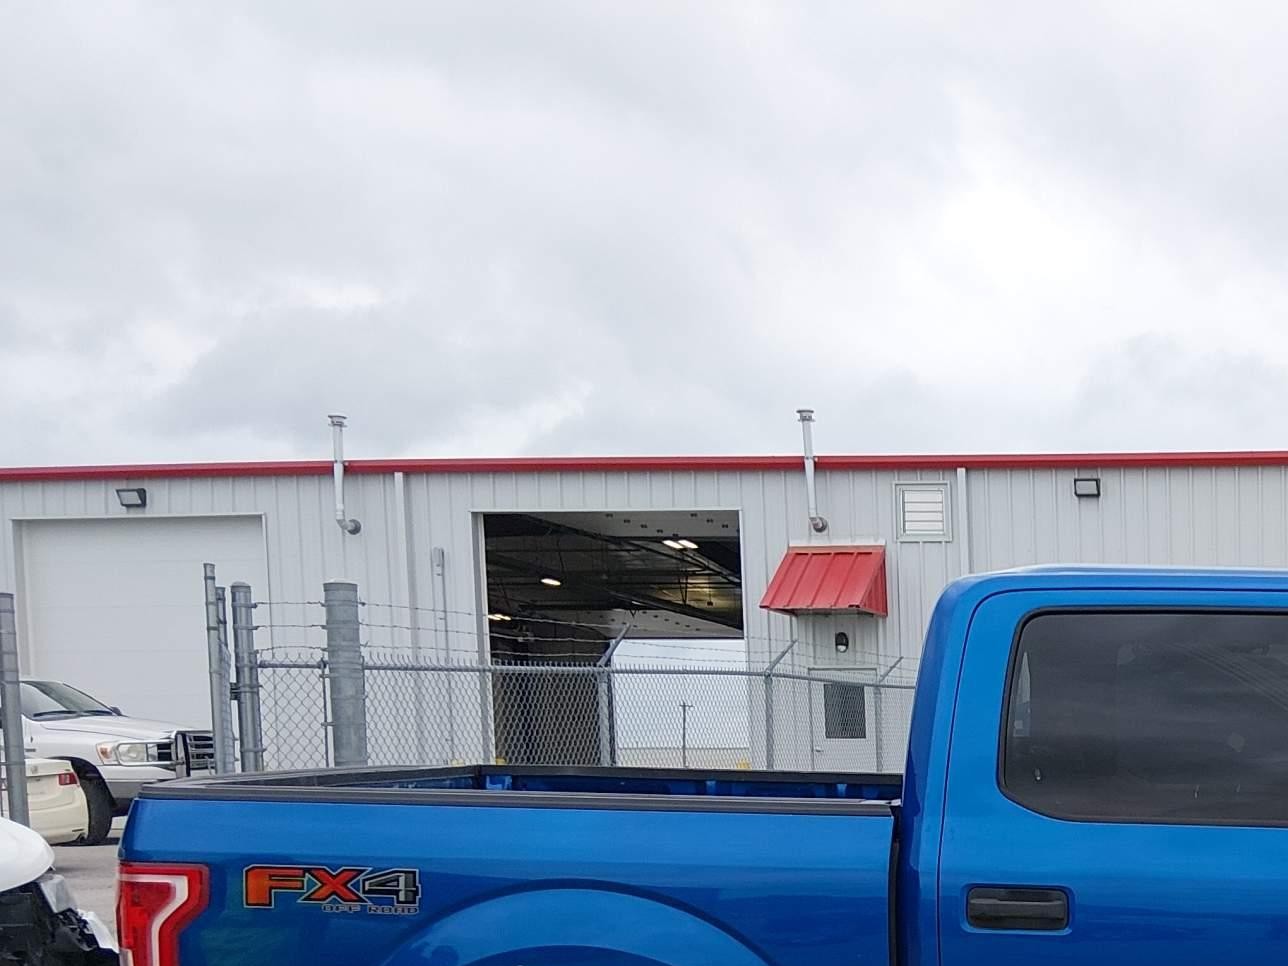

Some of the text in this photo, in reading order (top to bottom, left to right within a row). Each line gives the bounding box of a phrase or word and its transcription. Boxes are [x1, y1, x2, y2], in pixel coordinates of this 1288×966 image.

[243, 864, 421, 908] FX4
[321, 903, 419, 915] OFF ROAD
